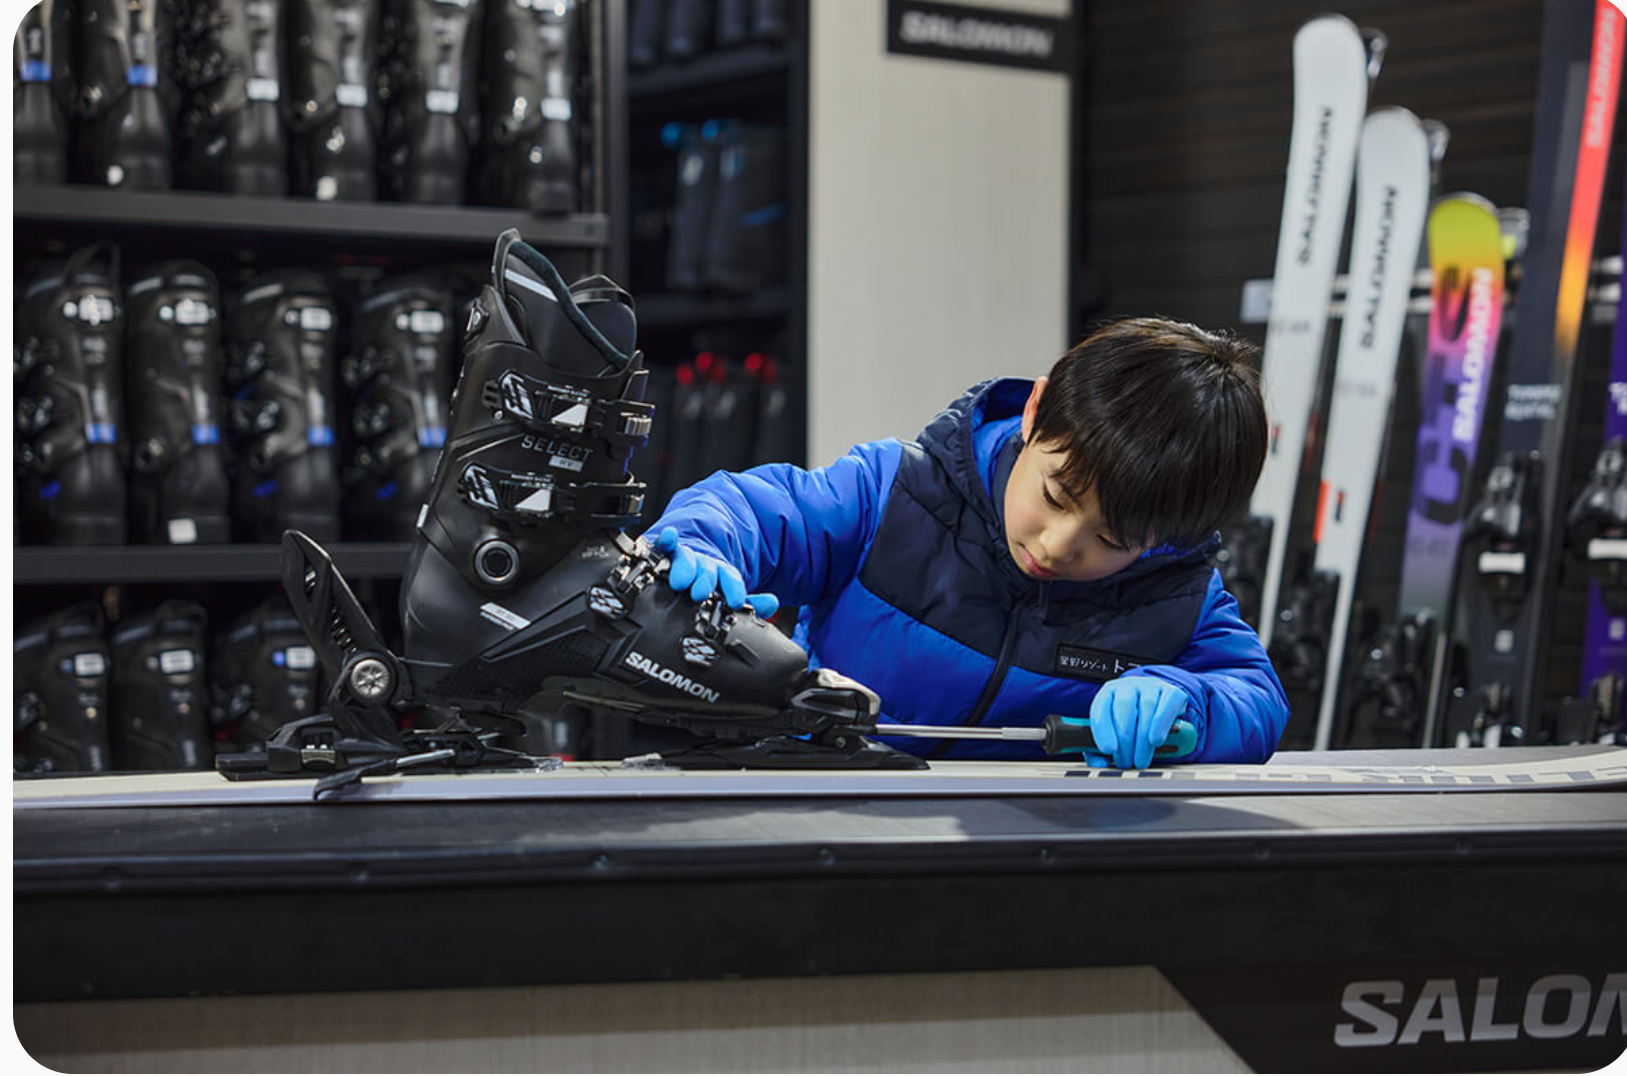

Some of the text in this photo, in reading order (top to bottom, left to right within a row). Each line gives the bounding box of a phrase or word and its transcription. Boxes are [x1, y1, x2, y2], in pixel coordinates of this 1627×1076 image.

[1452, 267, 1493, 441] SALOMON
[521, 436, 594, 461] SELECT
[625, 652, 720, 703] SALOMON
[1060, 656, 1108, 671] 星野リゾート
